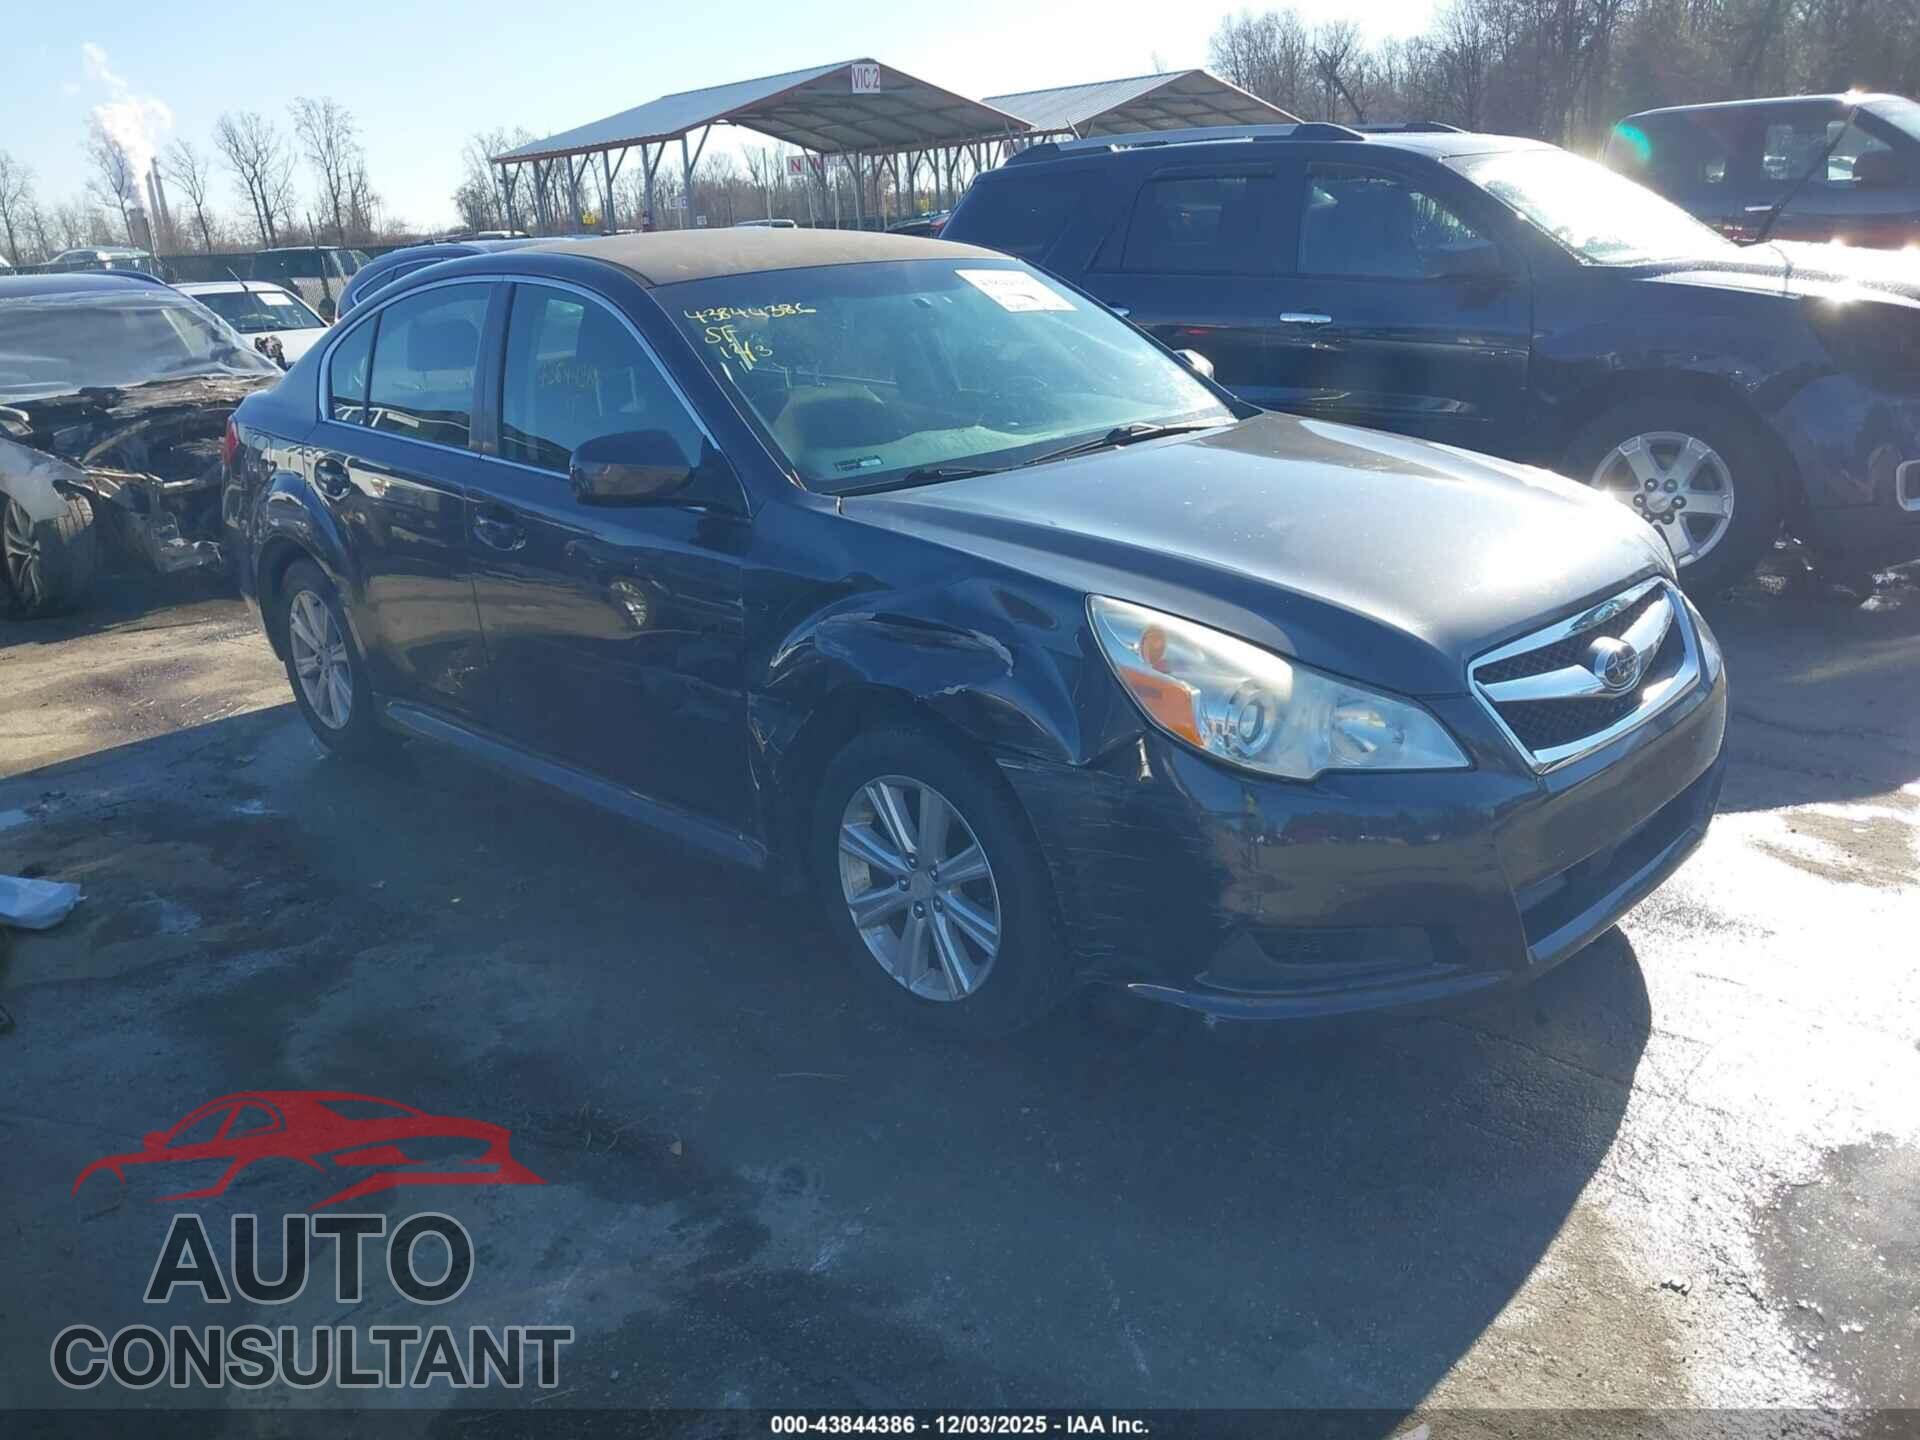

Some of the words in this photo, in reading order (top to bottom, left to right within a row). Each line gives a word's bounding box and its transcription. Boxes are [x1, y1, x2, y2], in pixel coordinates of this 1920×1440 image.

[852, 67, 870, 89] VIC
[872, 68, 880, 89] 2
[791, 159, 801, 171] N
